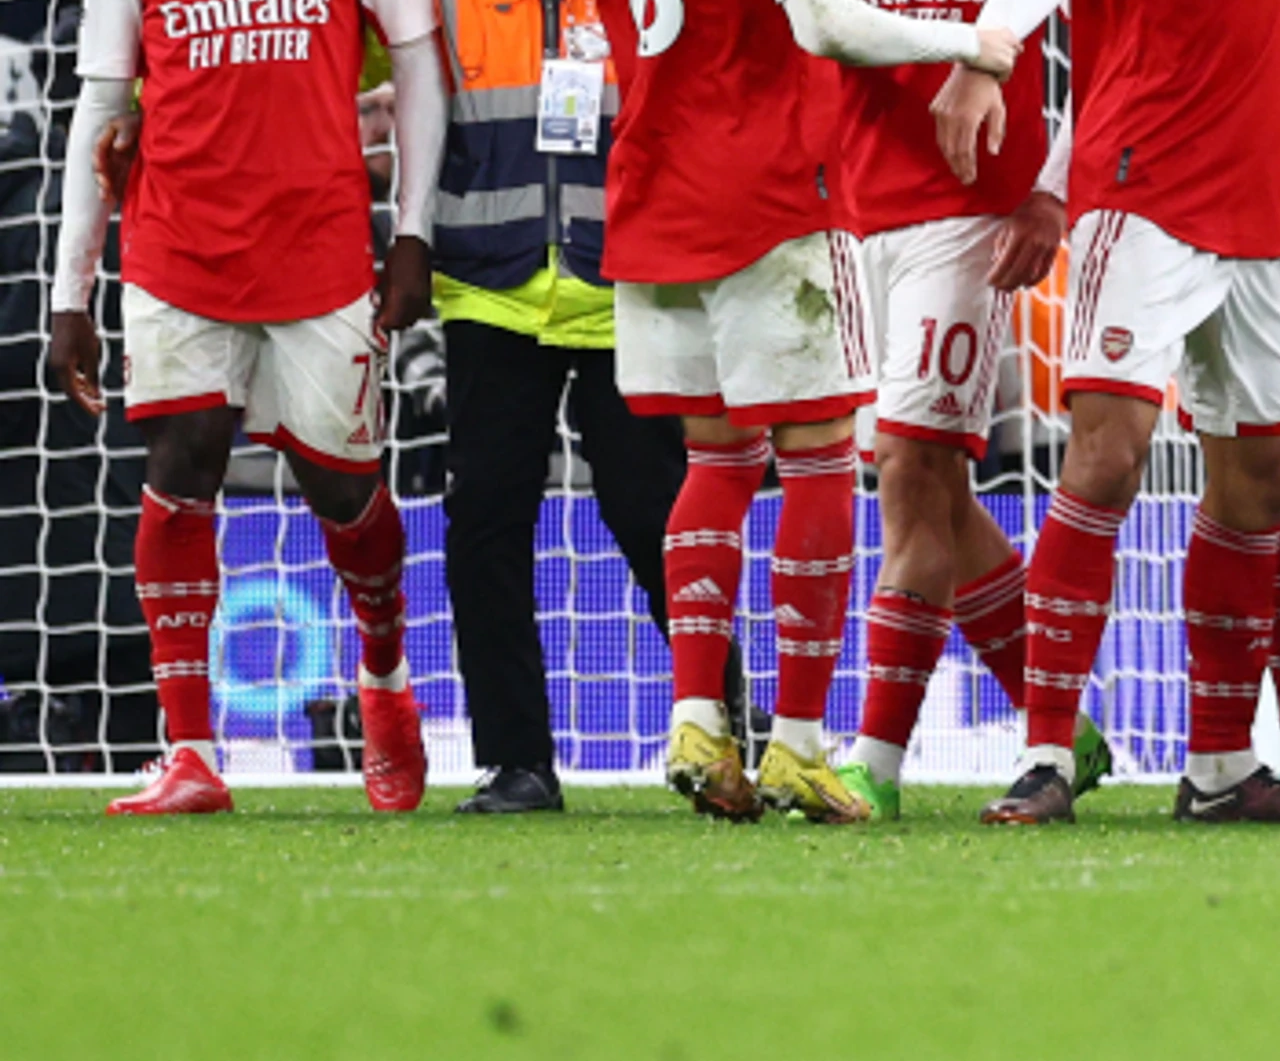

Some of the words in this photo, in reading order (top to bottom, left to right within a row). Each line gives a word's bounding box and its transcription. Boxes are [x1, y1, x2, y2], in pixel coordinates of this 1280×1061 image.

[188, 34, 224, 70] FLY
[229, 29, 311, 64] BETTER
[918, 316, 978, 386] 10
[351, 352, 371, 415] 7
